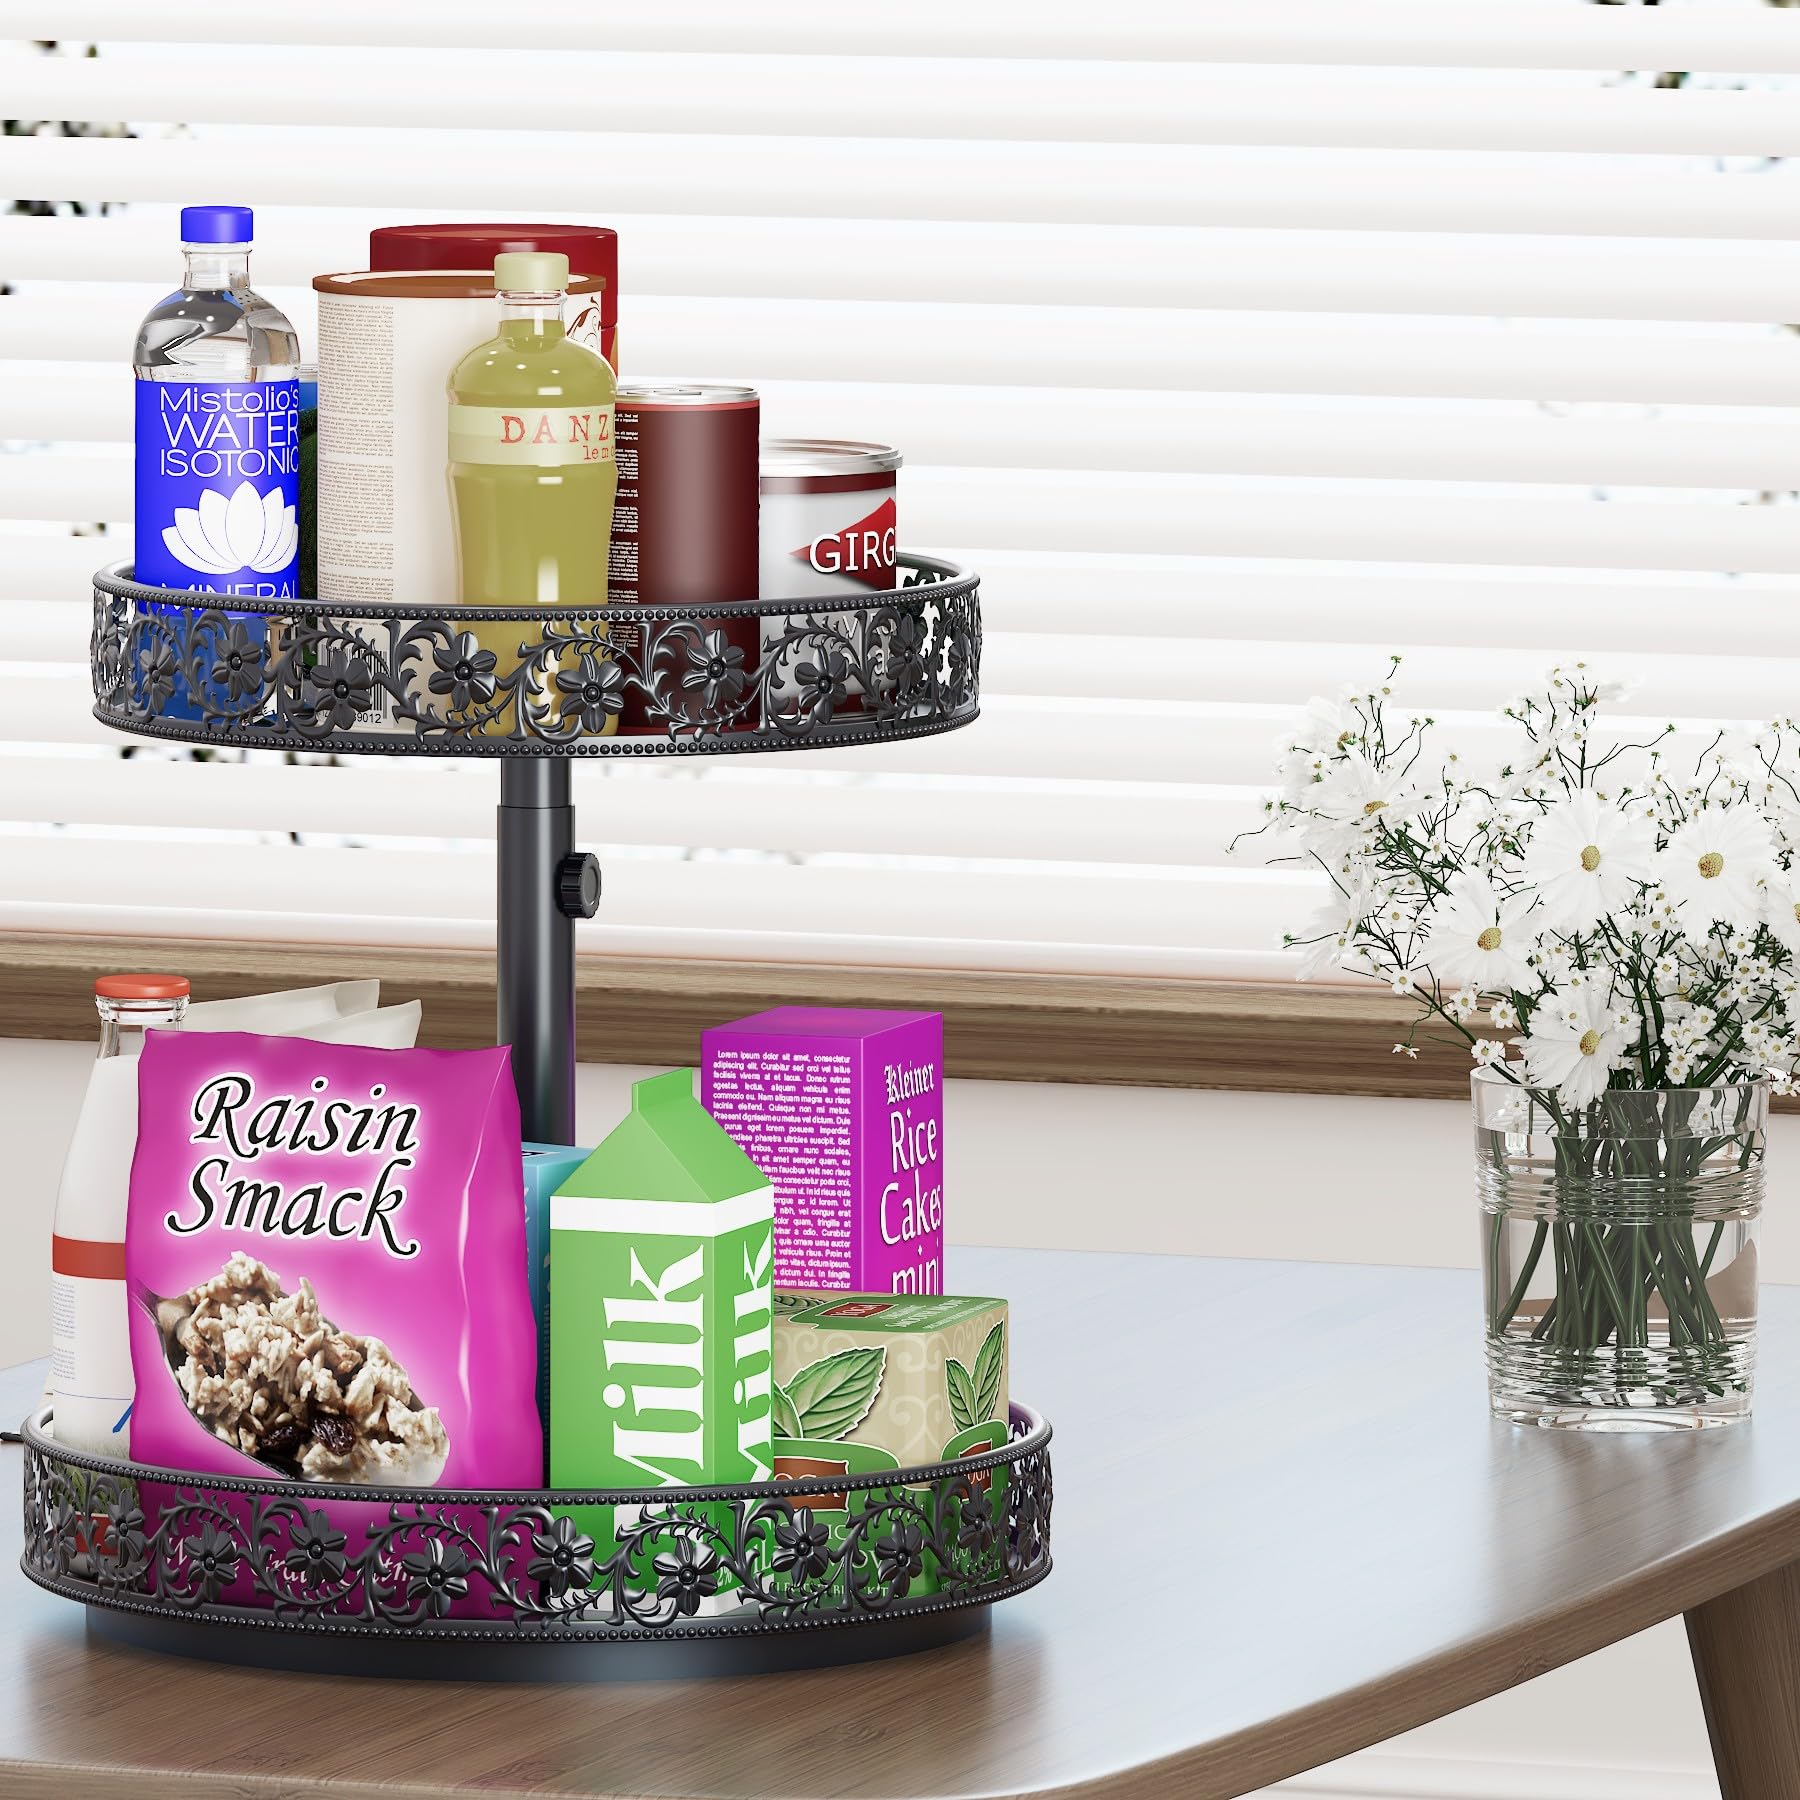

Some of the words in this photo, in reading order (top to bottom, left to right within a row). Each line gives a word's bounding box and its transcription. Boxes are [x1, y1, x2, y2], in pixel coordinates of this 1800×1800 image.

[160, 385, 298, 413] Mistolio's
[161, 411, 298, 449] WATER
[500, 414, 609, 443] DANZ
[160, 447, 298, 477] ISOTONIC
[809, 526, 896, 574] GIRG
[884, 1060, 935, 1105] Kleiner
[194, 1076, 417, 1159] Raisin
[890, 1107, 937, 1174] Rice
[167, 1158, 418, 1256] Smack
[880, 1168, 941, 1245] Cakes
[602, 1243, 704, 1541] Milk
